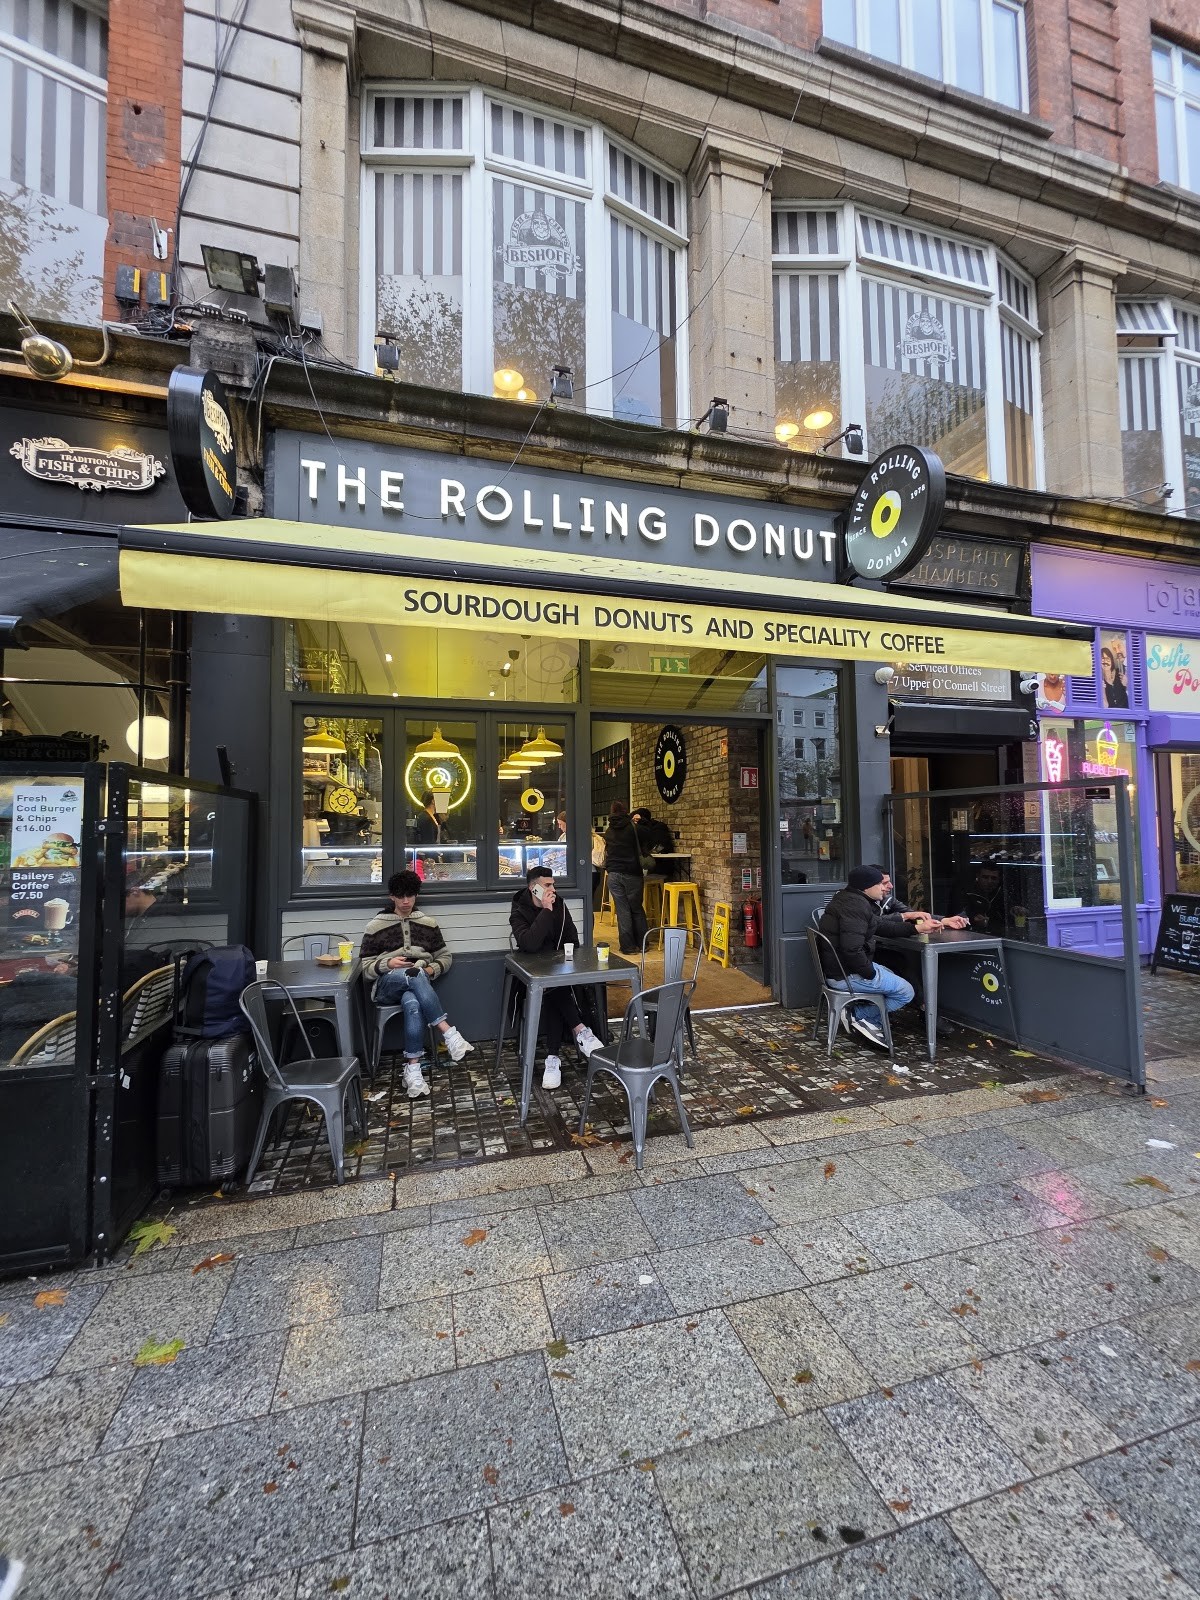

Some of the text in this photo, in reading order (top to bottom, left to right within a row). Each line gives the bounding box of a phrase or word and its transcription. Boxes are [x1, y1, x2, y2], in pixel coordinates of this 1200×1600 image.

[510, 248, 571, 265] BESHOFF
[906, 342, 948, 355] BESHOFF
[60, 454, 120, 467] TRADITIONAL
[38, 459, 140, 480] FISH & CHIPS
[853, 454, 921, 523] THE ROLLING
[301, 459, 836, 562] THE ROLLING DONUT
[866, 536, 908, 570] DONUT
[404, 589, 946, 655] SOURDOUGH DONUTS AND SPECIALITY COFFEE
[1147, 642, 1190, 673] Selfie
[908, 663, 948, 674] Serviced
[902, 677, 931, 691] Upper
[932, 678, 979, 692] O'Connell
[980, 682, 1006, 693] Street
[46, 748, 87, 759] CHIPS
[16, 794, 47, 802] Fresh
[16, 804, 77, 814] Cod Burger
[27, 815, 57, 824] Chips
[12, 872, 54, 882] Baileys
[12, 882, 50, 890] Coffee
[11, 891, 43, 900] €7.50
[1171, 904, 1188, 914] WE
[973, 962, 982, 974] THE
[980, 993, 1003, 1005] DONUT
